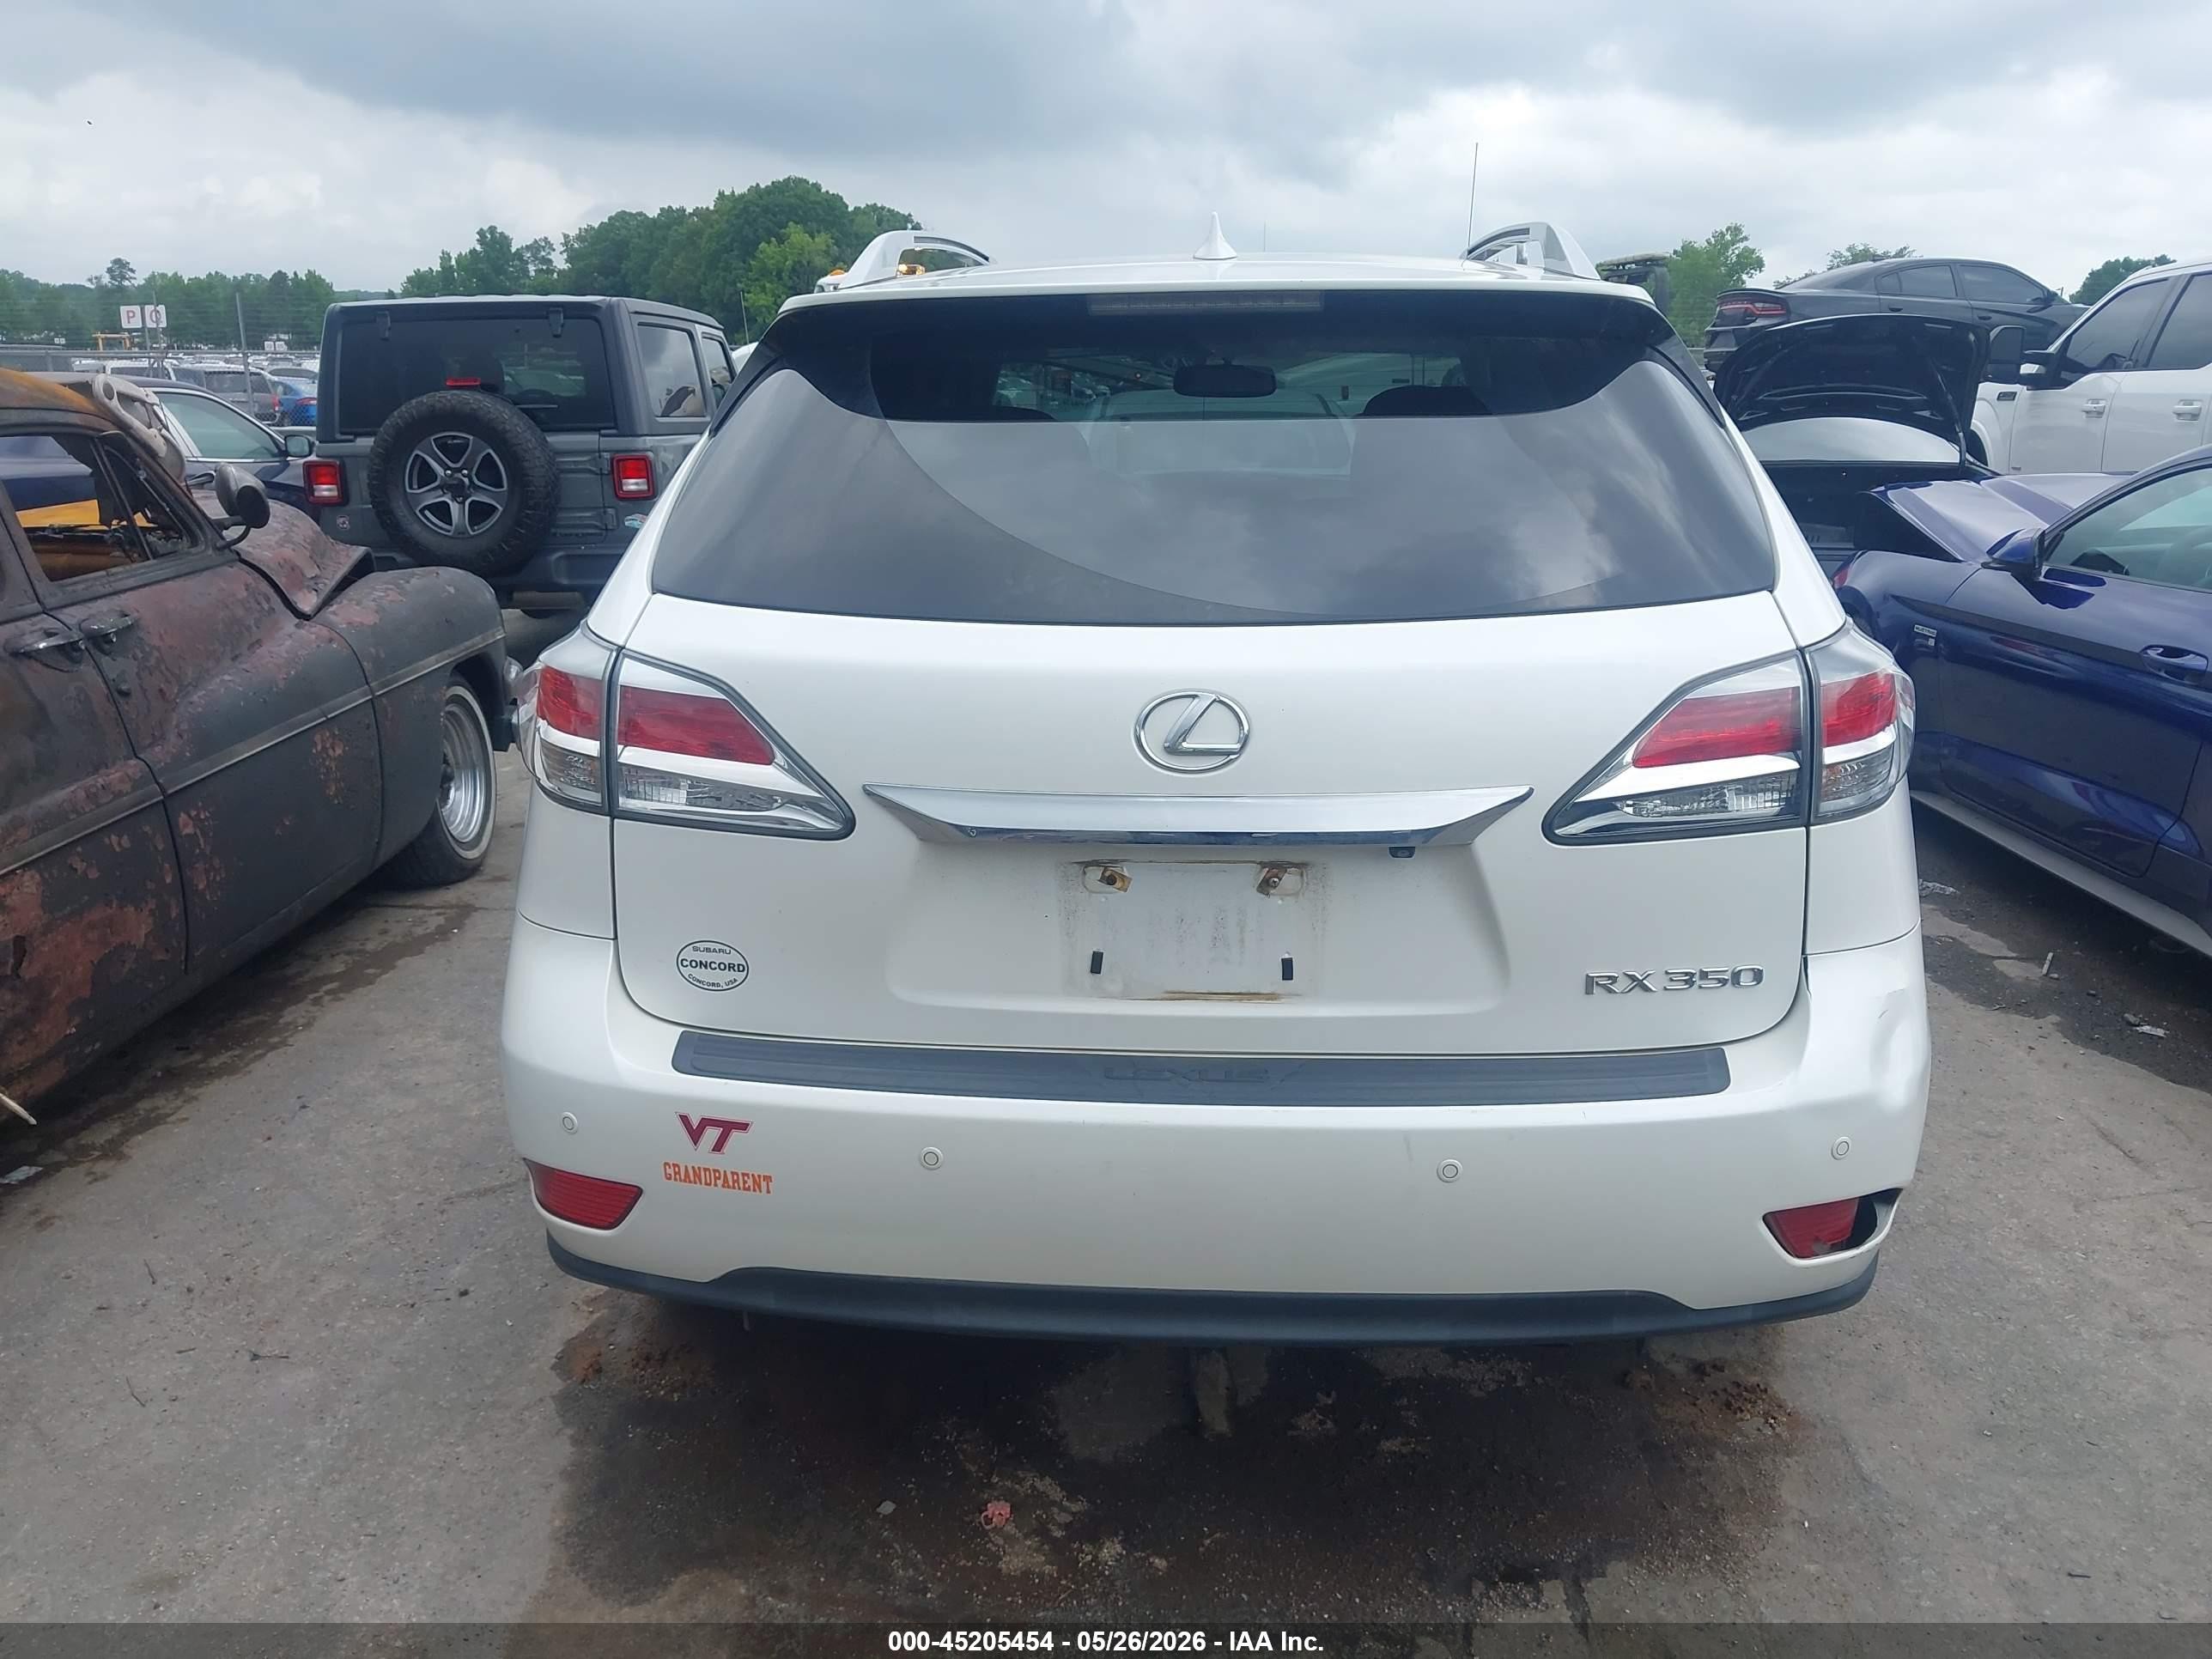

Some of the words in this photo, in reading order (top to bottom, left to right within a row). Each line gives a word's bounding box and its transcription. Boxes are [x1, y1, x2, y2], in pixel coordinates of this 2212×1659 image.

[126, 309, 136, 325] P
[692, 945, 732, 955] SUBARU
[680, 957, 745, 973] CONCORD
[688, 973, 724, 988] CONCORD,
[724, 977, 738, 987] USA
[1585, 969, 1658, 995] RX
[1663, 964, 1764, 991] 350
[676, 1112, 753, 1154] VT
[663, 1161, 774, 1194] GRANDPARENT
